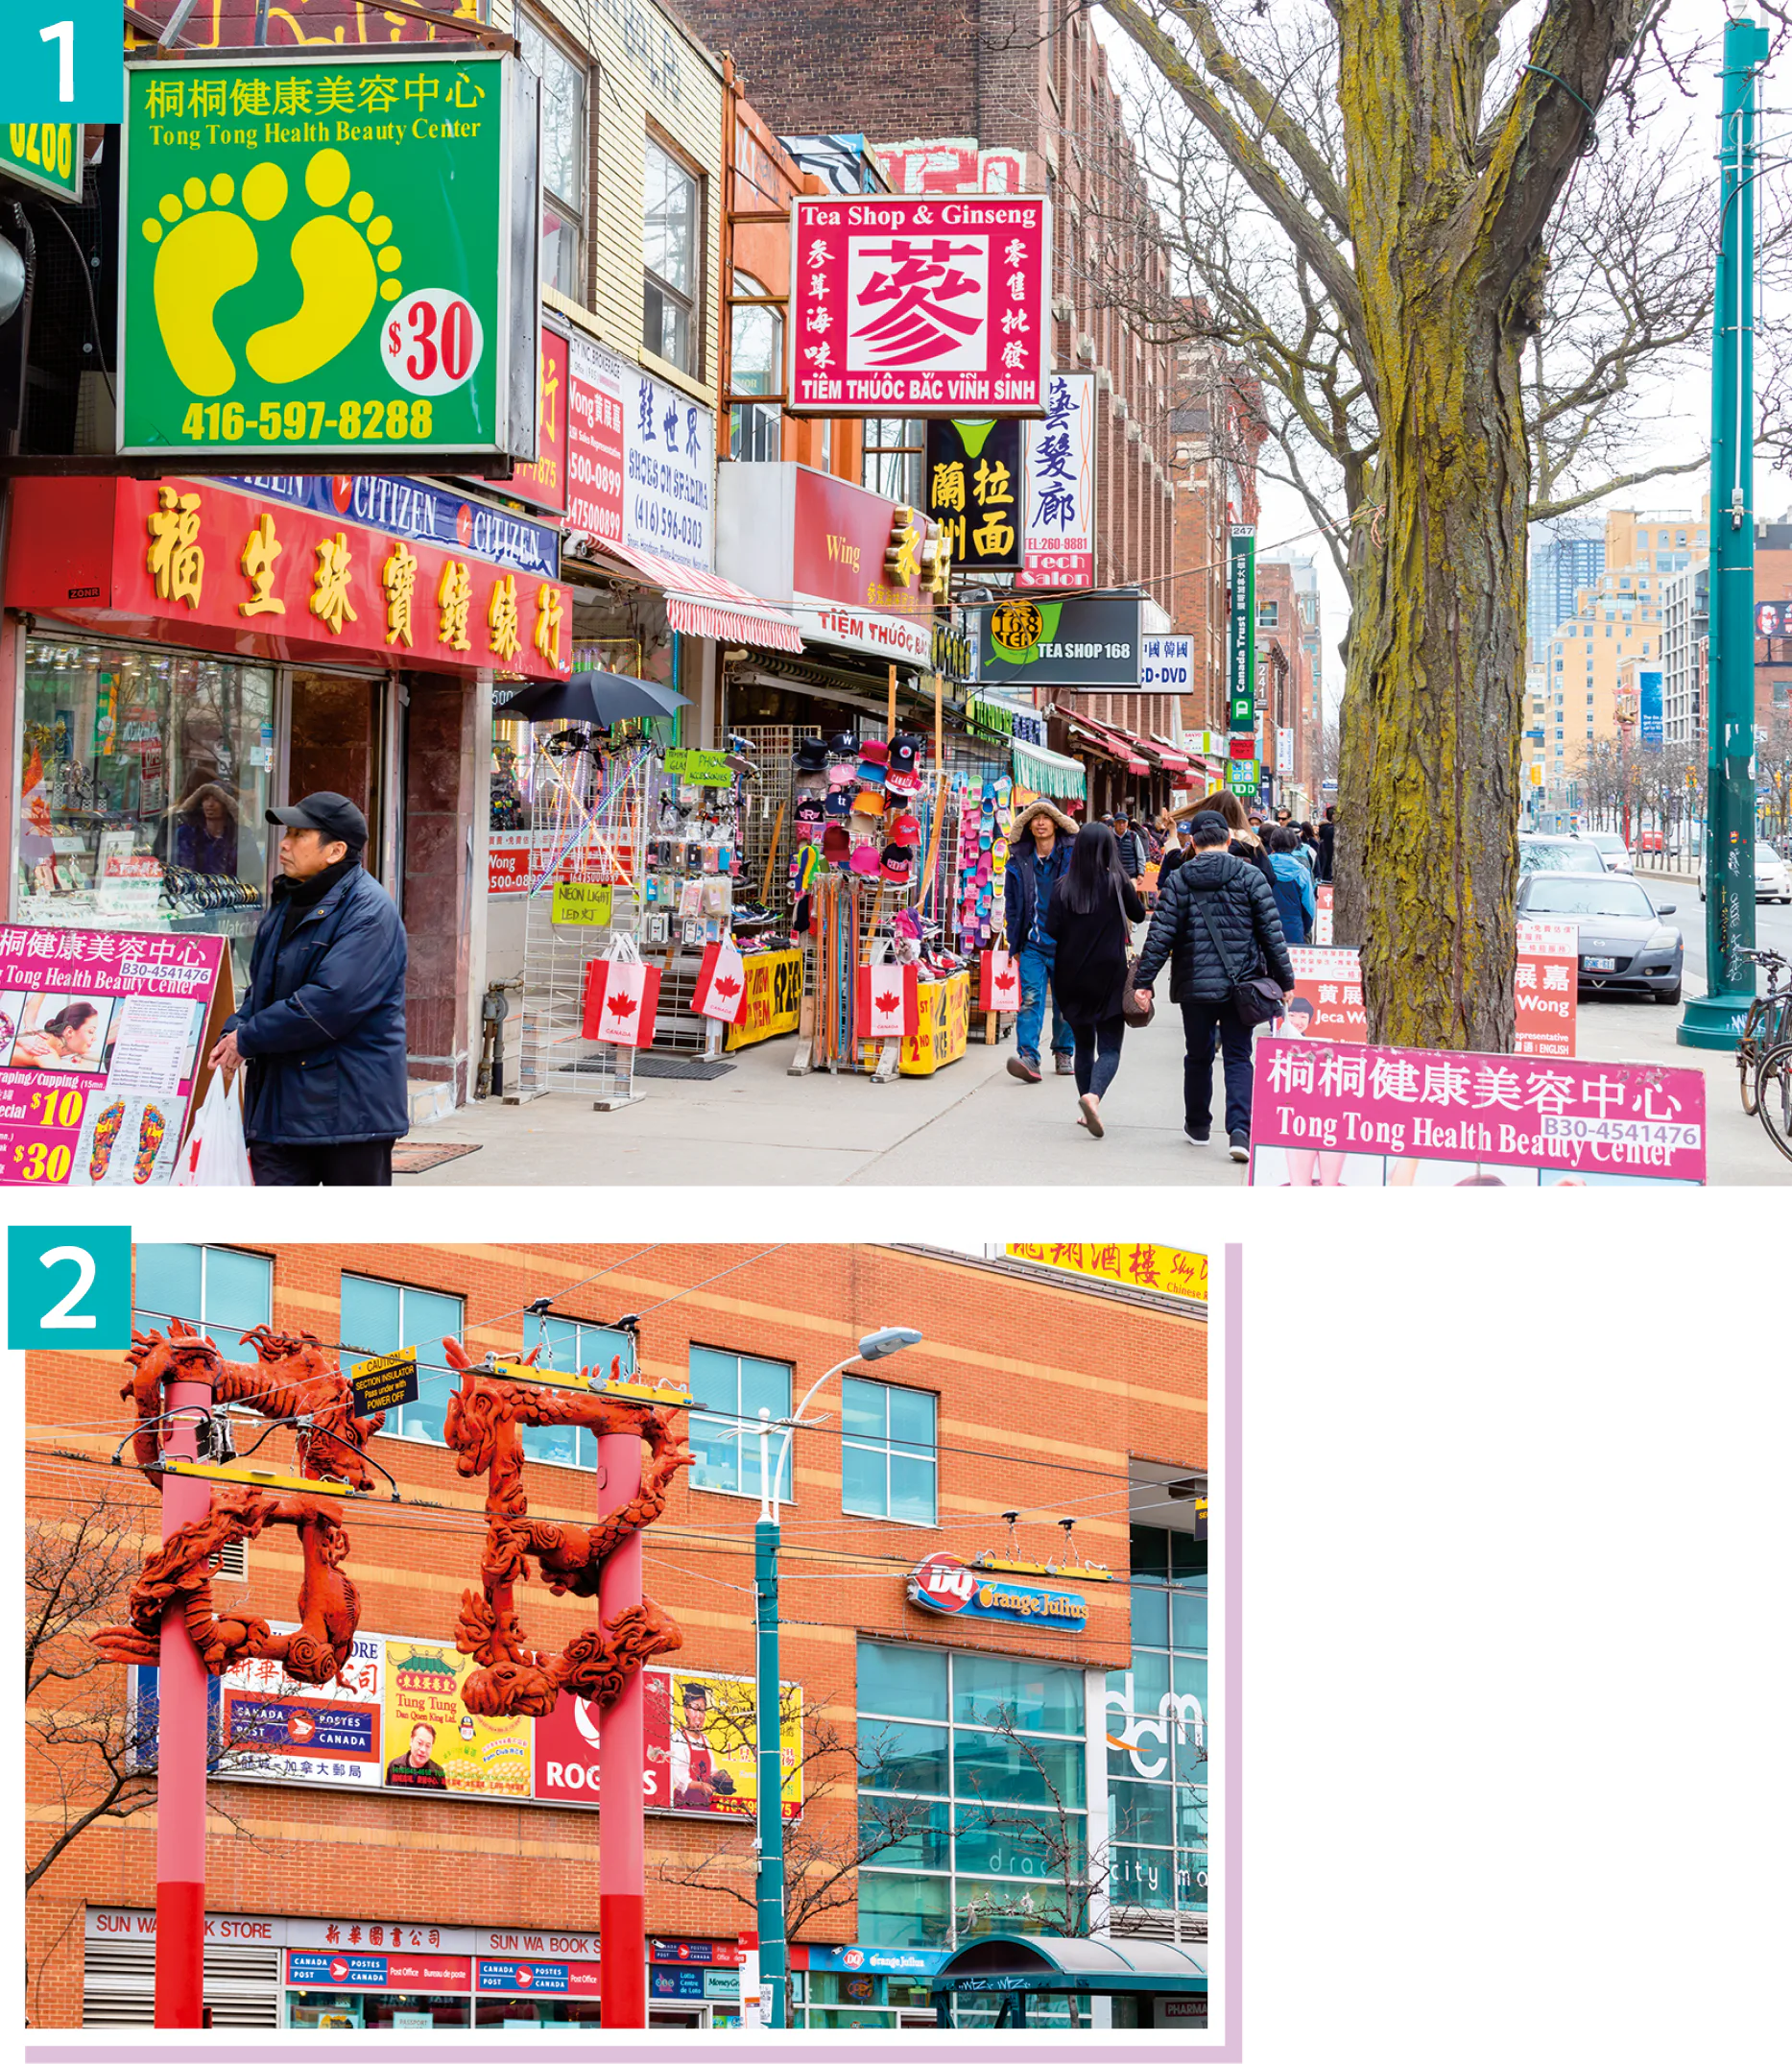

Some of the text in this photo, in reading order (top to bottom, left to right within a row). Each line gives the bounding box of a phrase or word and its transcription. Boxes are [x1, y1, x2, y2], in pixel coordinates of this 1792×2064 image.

[145, 73, 487, 119] 桐桐健康美容中心
[150, 117, 482, 150] Tong Tong Health Beauty Center
[801, 204, 1037, 230] Tea Shop & Ginseng
[388, 300, 474, 381] $30
[181, 400, 433, 442] 416-597-8288
[629, 447, 708, 511] SHOES ON SPADINA
[634, 493, 703, 549] (416) 596-0303
[474, 511, 541, 566] CITIZEN
[826, 534, 861, 574] Wing
[1026, 554, 1085, 569] Tech
[1021, 571, 1089, 587] Salon
[1000, 632, 1033, 647] TEA
[1037, 642, 1131, 659] TEA SHOP 168
[1236, 616, 1246, 693] Canada Trust
[1257, 665, 1267, 699] 241
[843, 735, 852, 746] W
[891, 774, 912, 787] CANADA
[559, 887, 609, 905] NEON LIGHT
[6, 965, 42, 992] Tong
[44, 968, 91, 990] Health
[121, 962, 209, 982] B30-4541476
[709, 1004, 732, 1015] CANADA
[1517, 995, 1569, 1018] Wong
[1315, 1010, 1345, 1025] Jeca
[606, 1028, 632, 1038] CANADA
[1540, 1044, 1569, 1055] ENGLISH
[1267, 1049, 1683, 1121] 桐桐健康美容中心
[31, 1090, 83, 1127] $10
[1276, 1106, 1338, 1146] Tong
[1343, 1111, 1405, 1154] Tong
[1412, 1118, 1493, 1153] Health
[1498, 1124, 1584, 1167] Beauty
[1543, 1117, 1698, 1146] B30-4541476
[13, 1142, 71, 1182] $30
[1170, 1253, 1195, 1283] Sky
[1167, 1282, 1201, 1299] Chinese
[355, 1364, 415, 1390] SECTION INSULATOR
[365, 1380, 407, 1399] Pass under with
[367, 1390, 405, 1409] POWER OFF
[928, 1565, 974, 1600] DQ
[979, 1584, 1089, 1619] Orange Julius
[237, 1707, 284, 1720] CANADA
[395, 1693, 457, 1714] Tung Tung
[320, 1716, 361, 1727] POSTES
[396, 1710, 409, 1719] Dan
[429, 1714, 443, 1723] King
[320, 1734, 366, 1746] CANADA
[546, 1762, 657, 1795] ROGS
[1111, 1860, 1158, 1890] city
[97, 1915, 131, 1933] SUN
[221, 1921, 273, 1939] STORE
[490, 1933, 518, 1951] SUN
[524, 1935, 544, 1952] WA
[549, 1937, 588, 1954] BOOK
[294, 1957, 327, 1966] CANADA
[484, 1965, 514, 1974] CANADA
[351, 1973, 385, 1981] CANADA
[390, 1967, 419, 1977] Post Office
[423, 1968, 442, 1979] Bureau
[443, 1969, 451, 1979] de
[570, 1975, 597, 1984] Post Office
